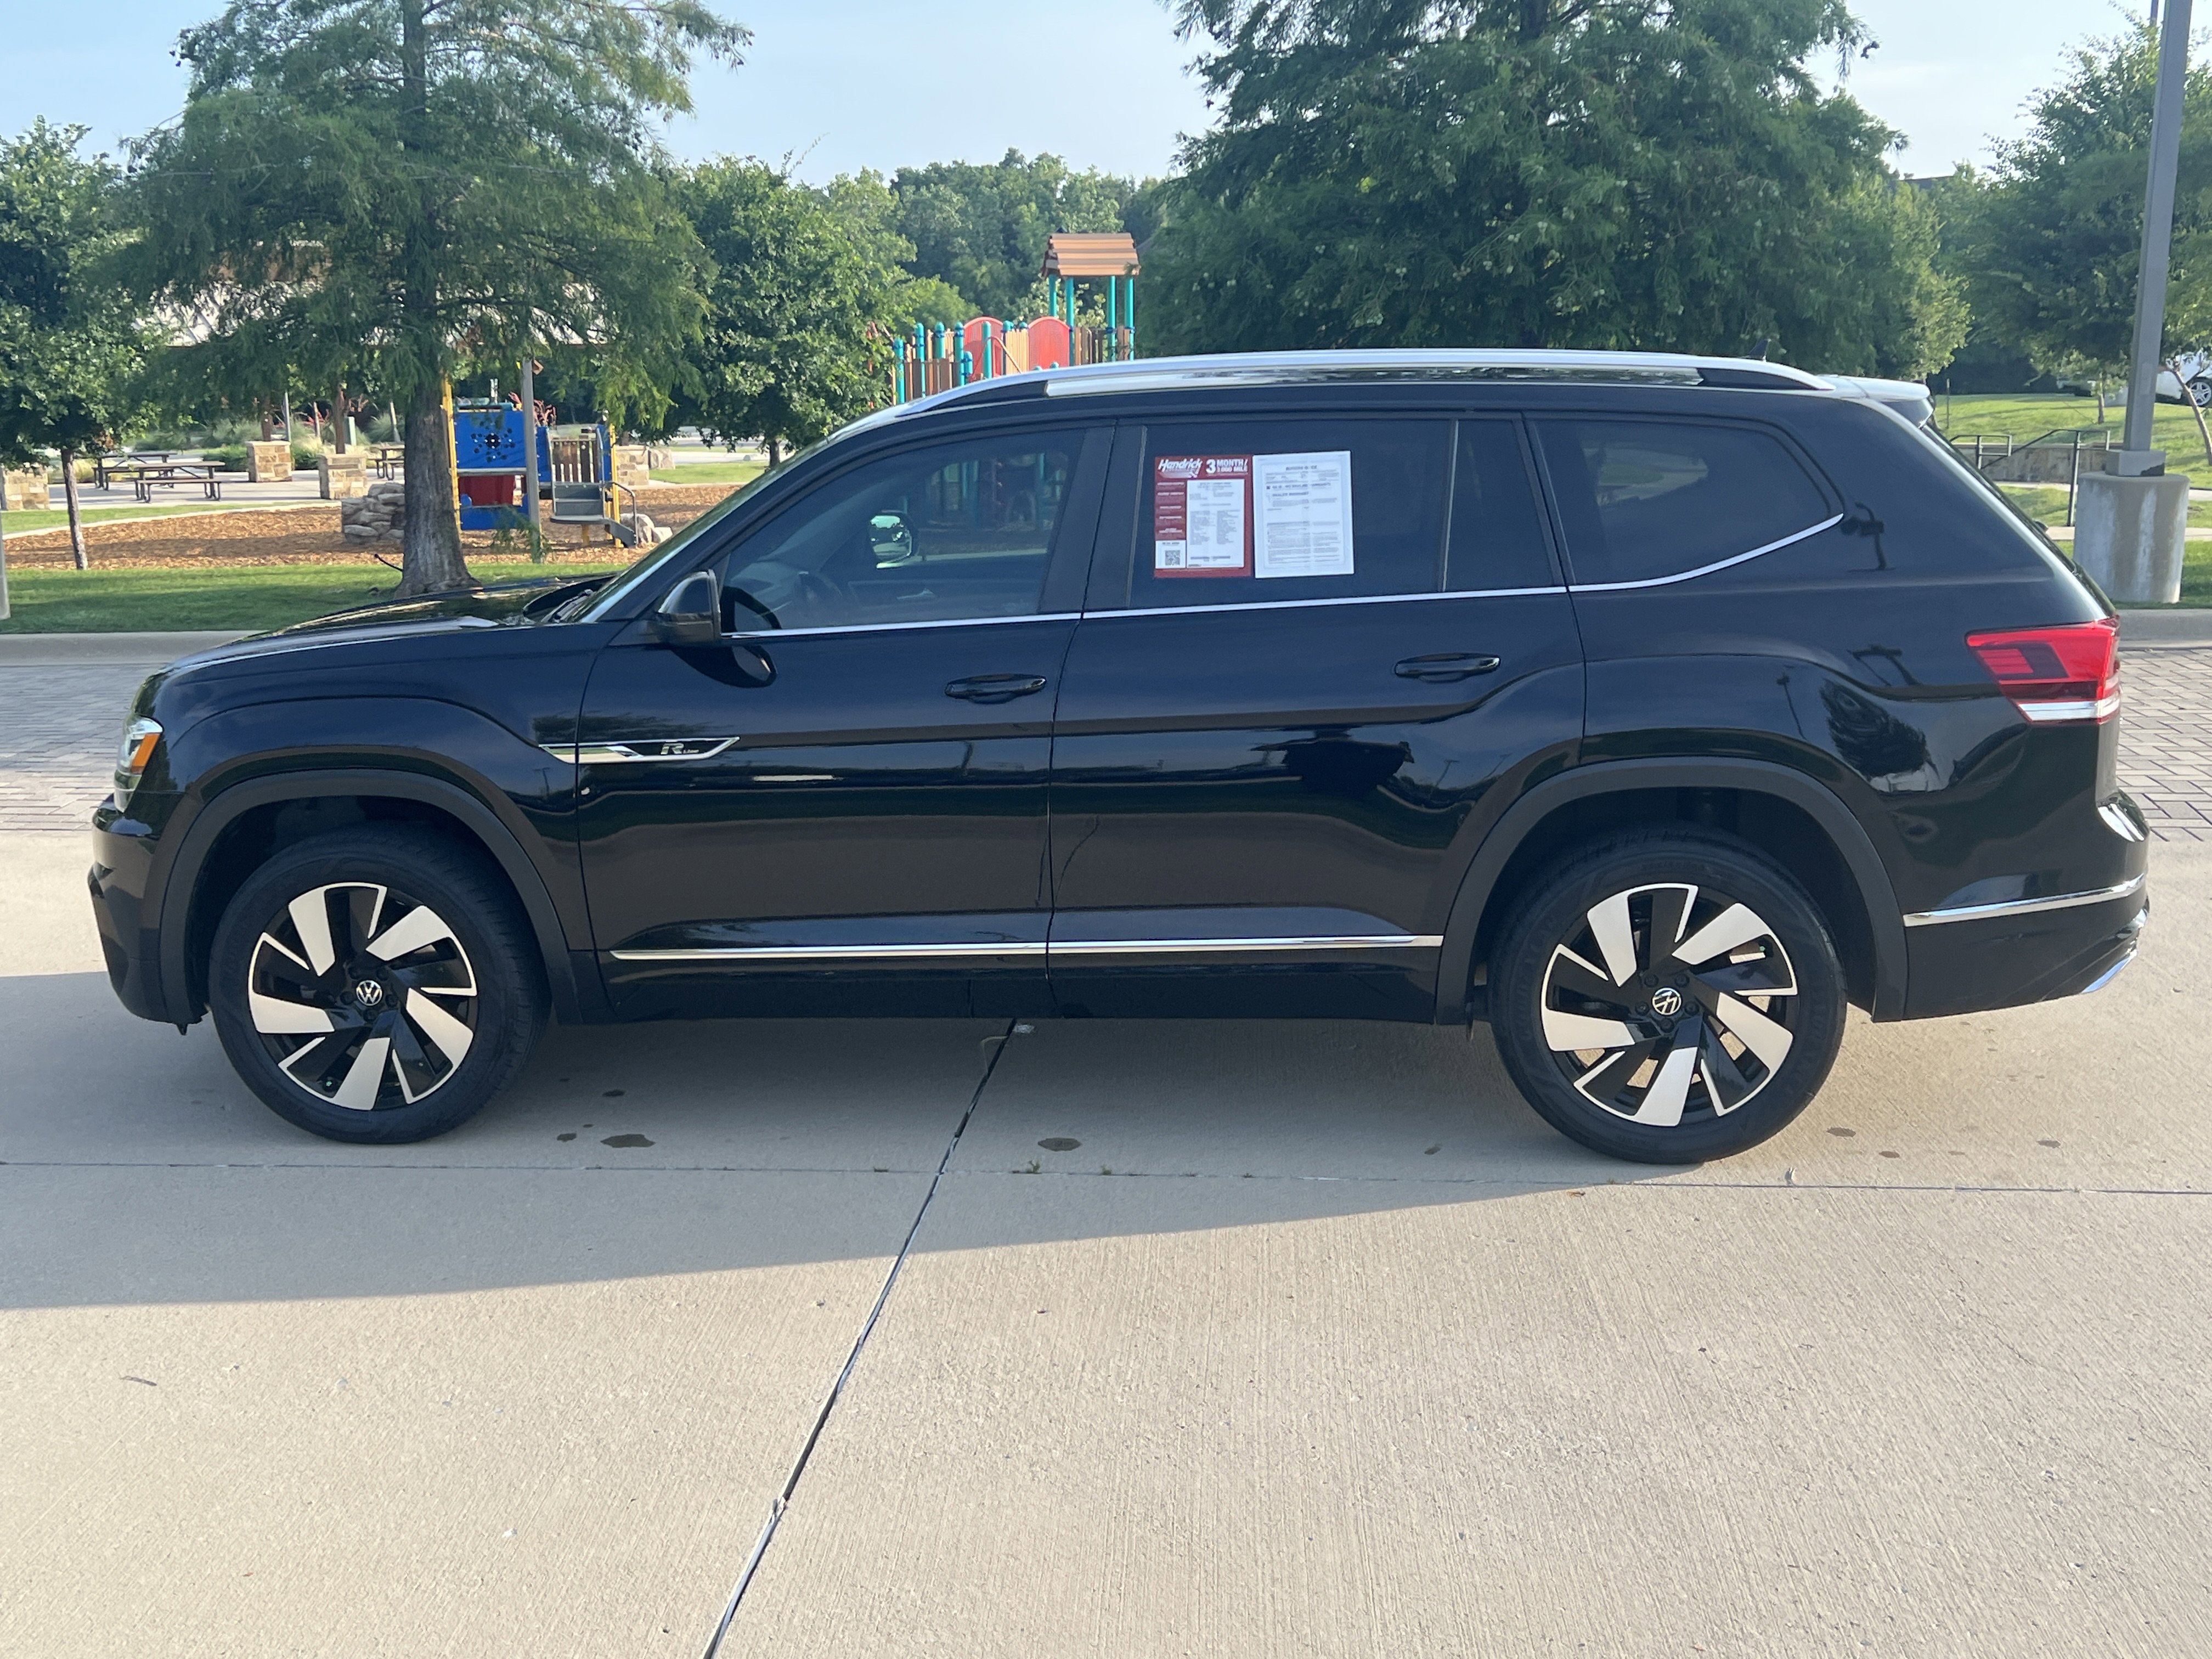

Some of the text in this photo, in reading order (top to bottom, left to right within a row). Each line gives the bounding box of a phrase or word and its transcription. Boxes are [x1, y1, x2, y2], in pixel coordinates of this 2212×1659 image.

[1206, 459, 1249, 473] 3 MONTH/
[661, 743, 684, 755] R
